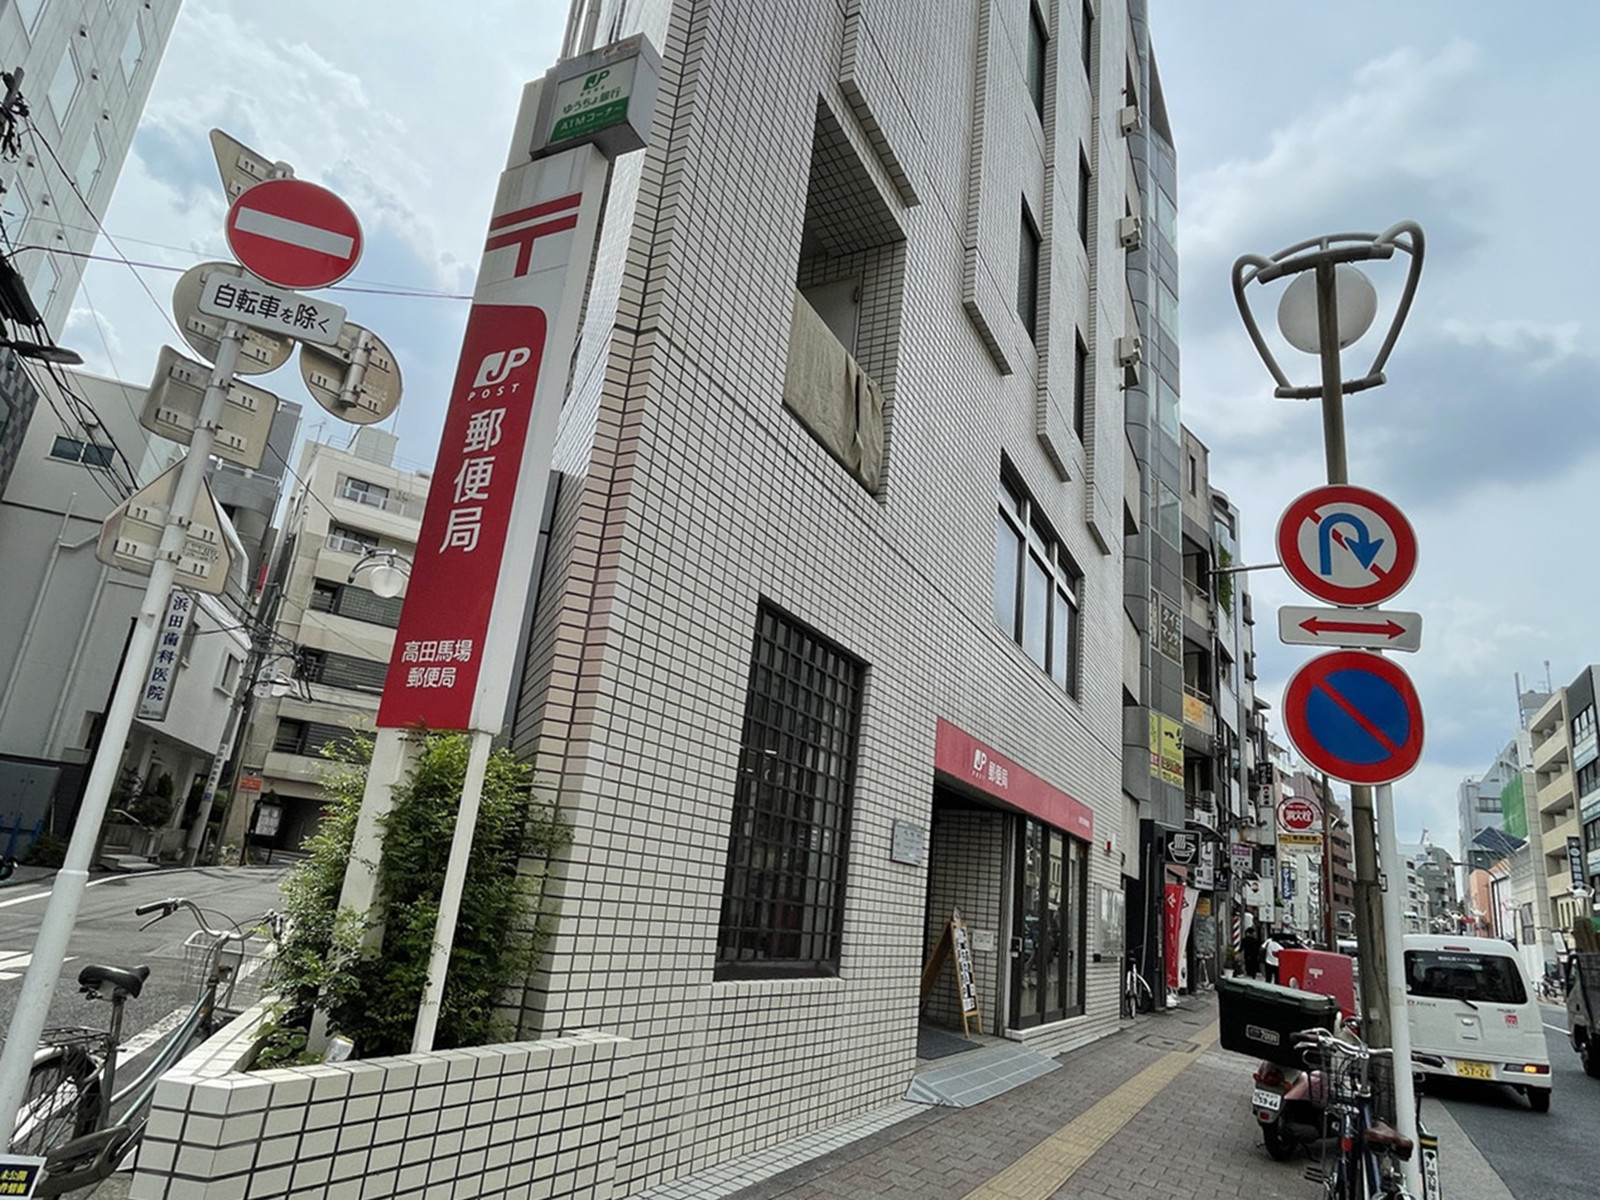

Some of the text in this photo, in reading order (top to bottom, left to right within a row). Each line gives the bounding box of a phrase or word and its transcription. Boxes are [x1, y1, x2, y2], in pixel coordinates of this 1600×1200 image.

[562, 86, 622, 115] ゆうちょ銀行
[560, 105, 625, 131] ATMコーナー
[213, 283, 331, 334] 自転車を除く
[467, 382, 521, 402] POST
[438, 407, 507, 555] 郵便局
[146, 595, 190, 702] 浜田歯科医院
[401, 639, 474, 664] 高田馬場
[406, 666, 457, 689] 郵便局
[988, 761, 1009, 790] 郵便局
